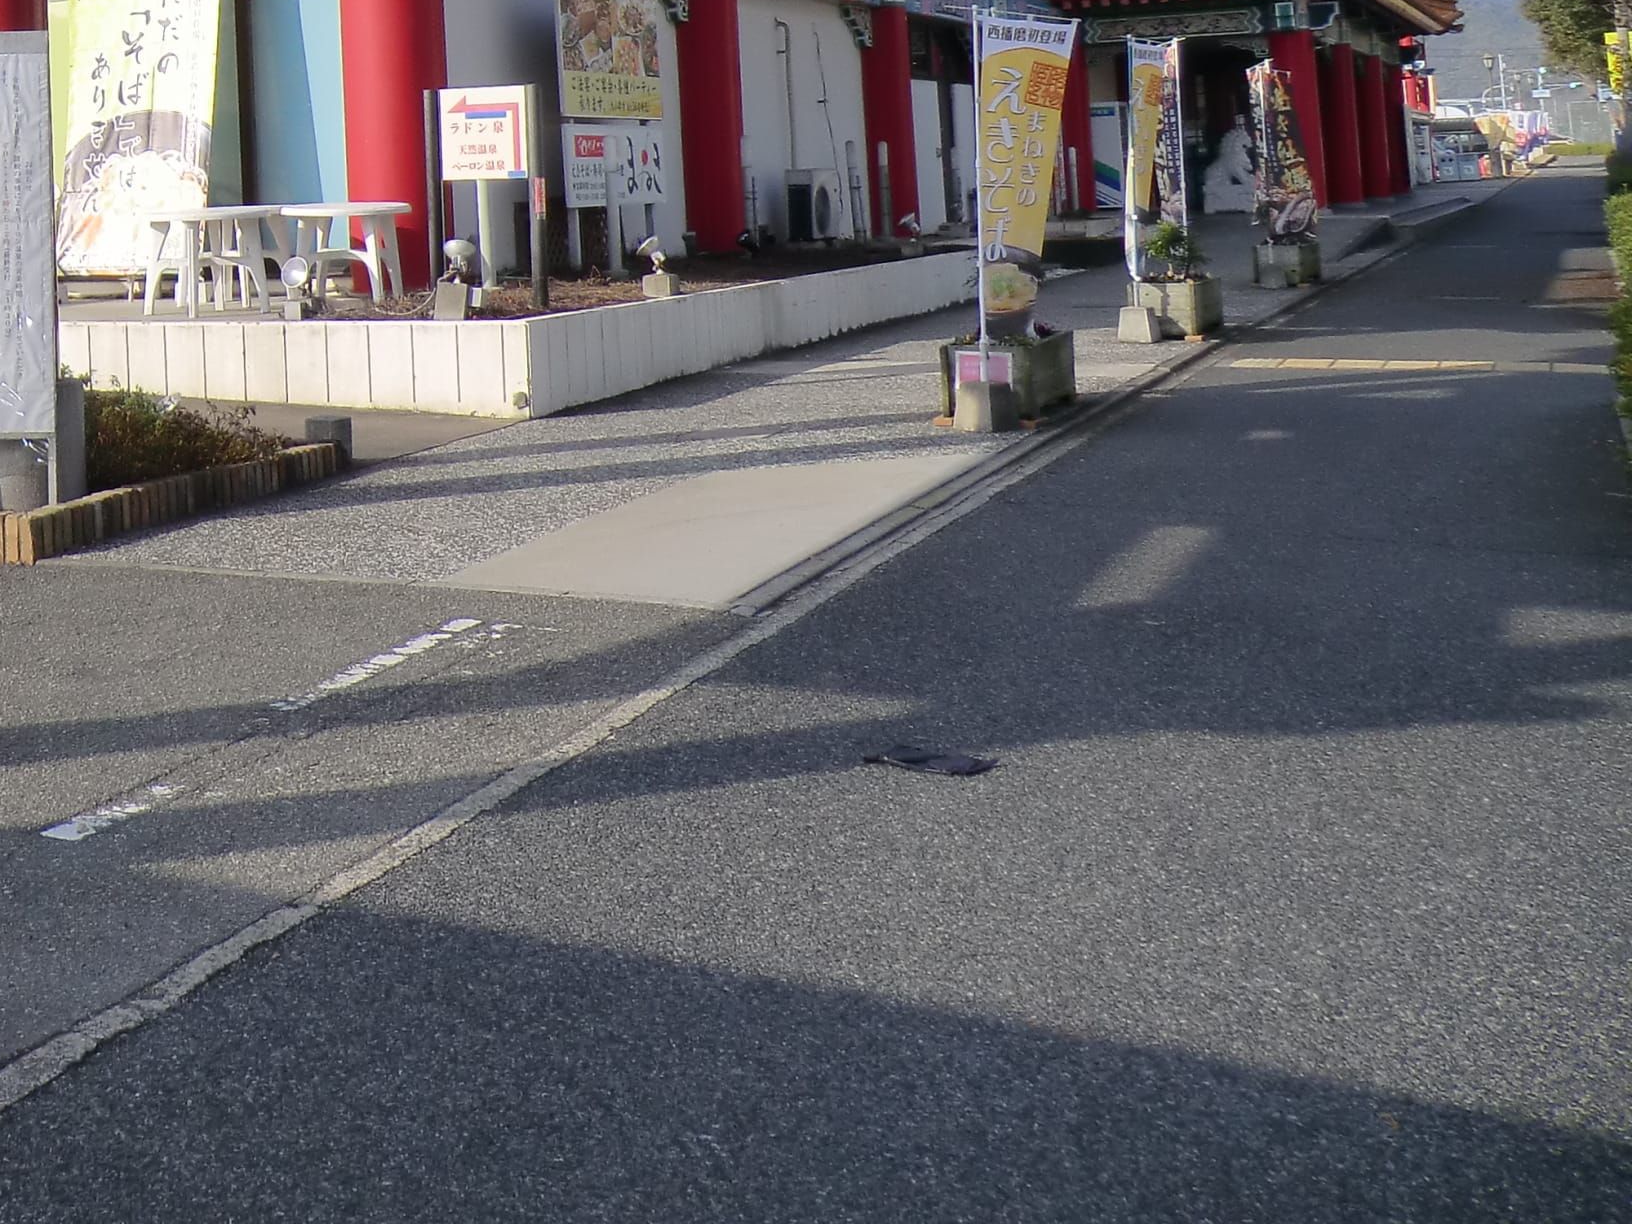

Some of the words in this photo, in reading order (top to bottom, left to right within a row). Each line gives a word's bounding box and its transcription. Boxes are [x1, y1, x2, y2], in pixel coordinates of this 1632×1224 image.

[987, 24, 1068, 45] 西播磨初登場
[450, 120, 505, 134] ラドン泉
[459, 143, 498, 155] 天然温泉
[452, 160, 505, 171] ペーロン温泉
[981, 64, 1027, 263] えきそば
[1016, 111, 1048, 207] まねきの
